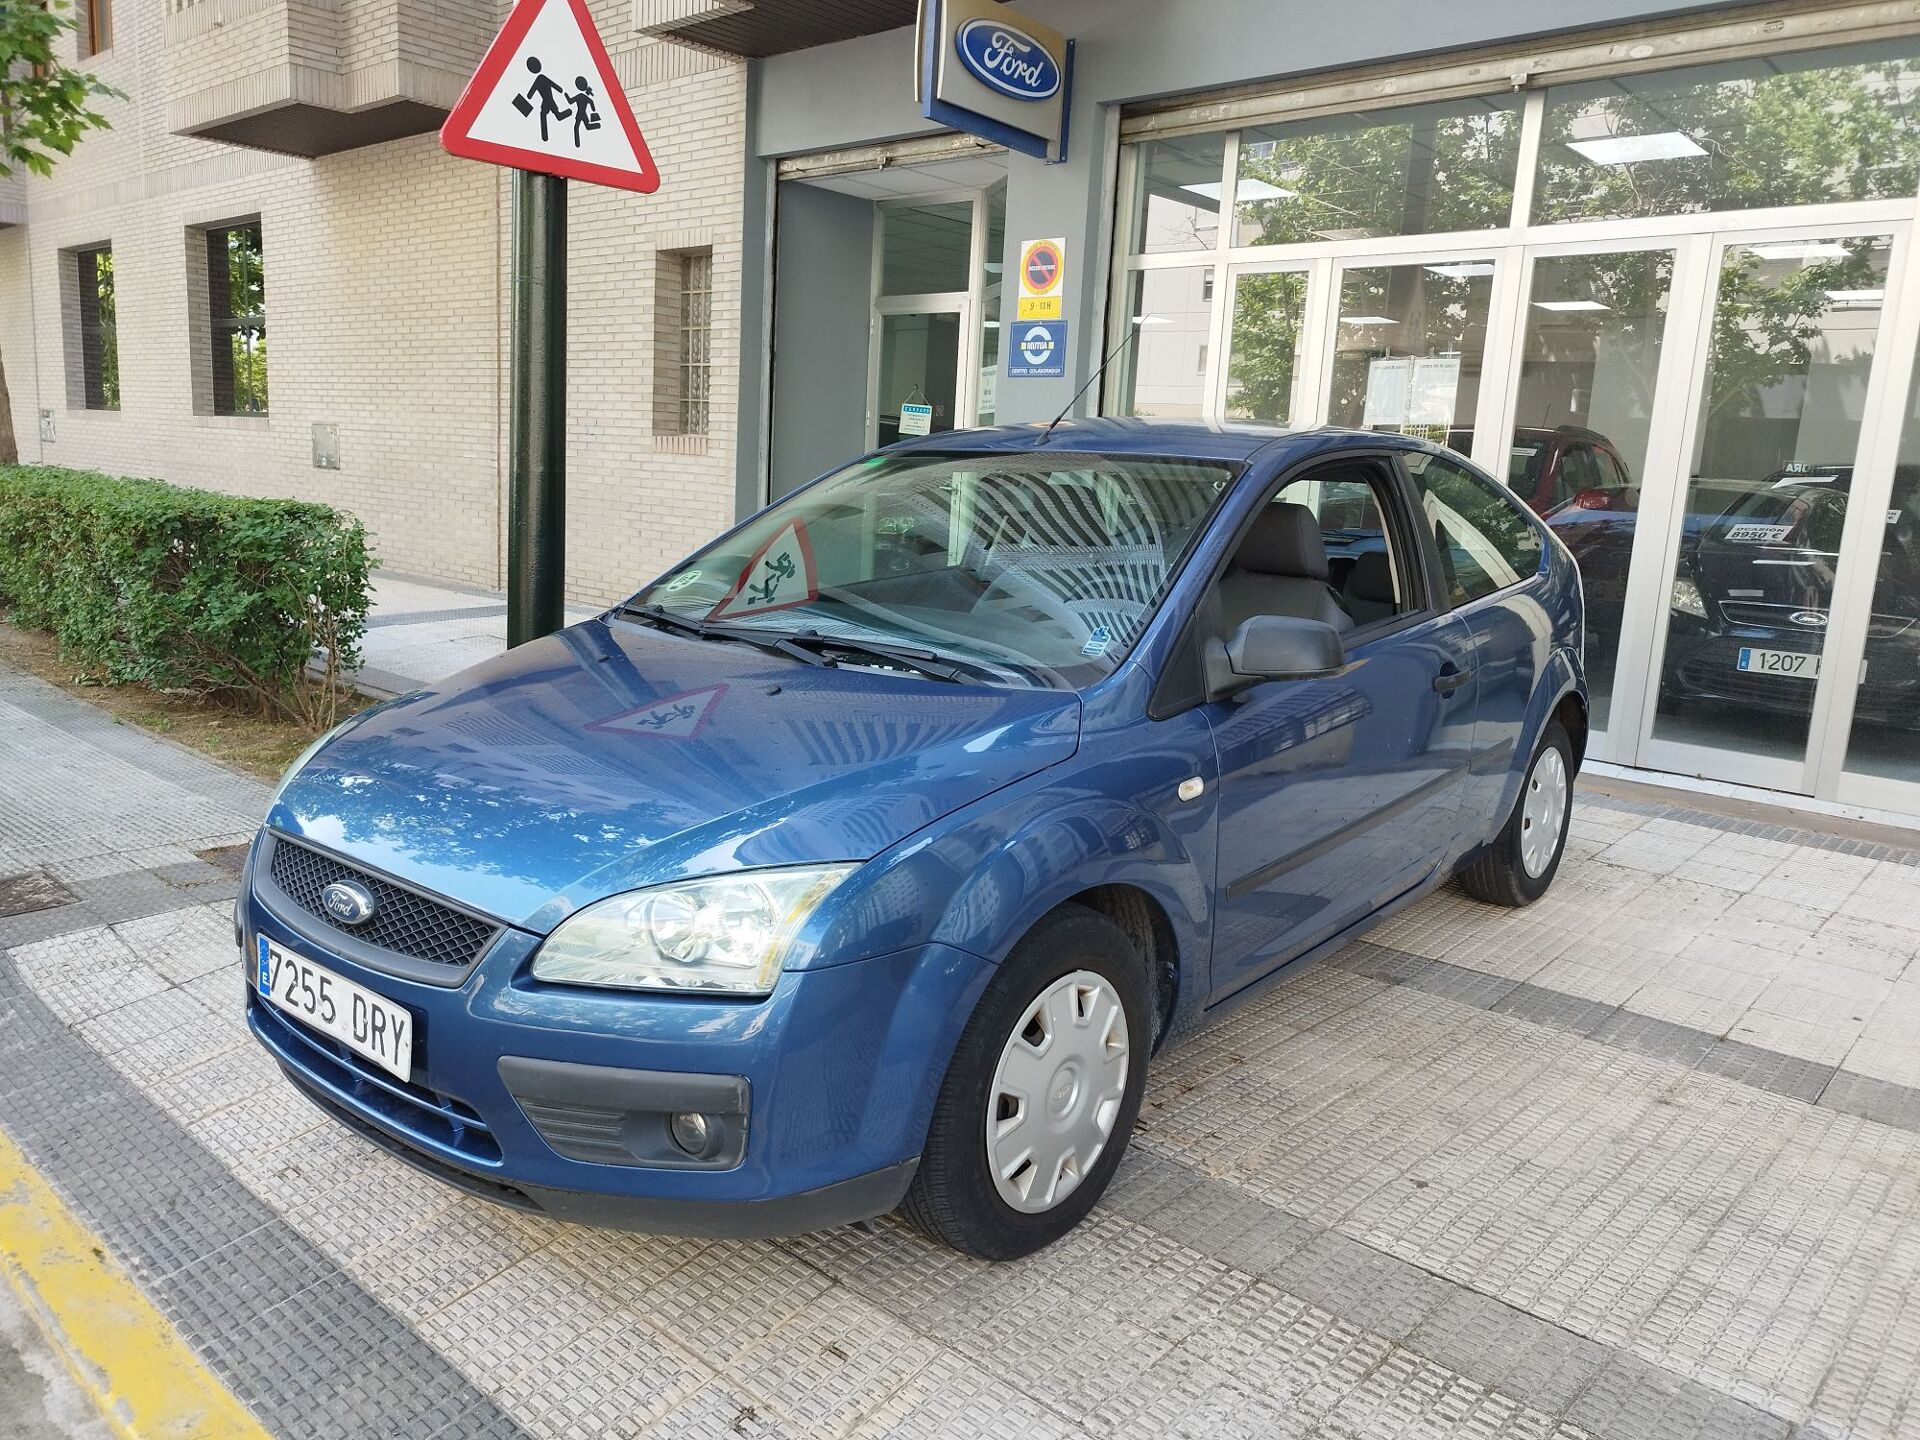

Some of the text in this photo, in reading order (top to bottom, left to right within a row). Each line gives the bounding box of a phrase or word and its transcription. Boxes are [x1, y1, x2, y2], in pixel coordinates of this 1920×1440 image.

[983, 31, 1044, 88] Ford
[1027, 341, 1048, 350] MUTUA
[1731, 531, 1768, 539] 8950
[1759, 652, 1807, 673] 1207
[327, 890, 353, 918] Ford
[262, 971, 271, 986] E
[269, 948, 406, 1066] 7255 DRY
